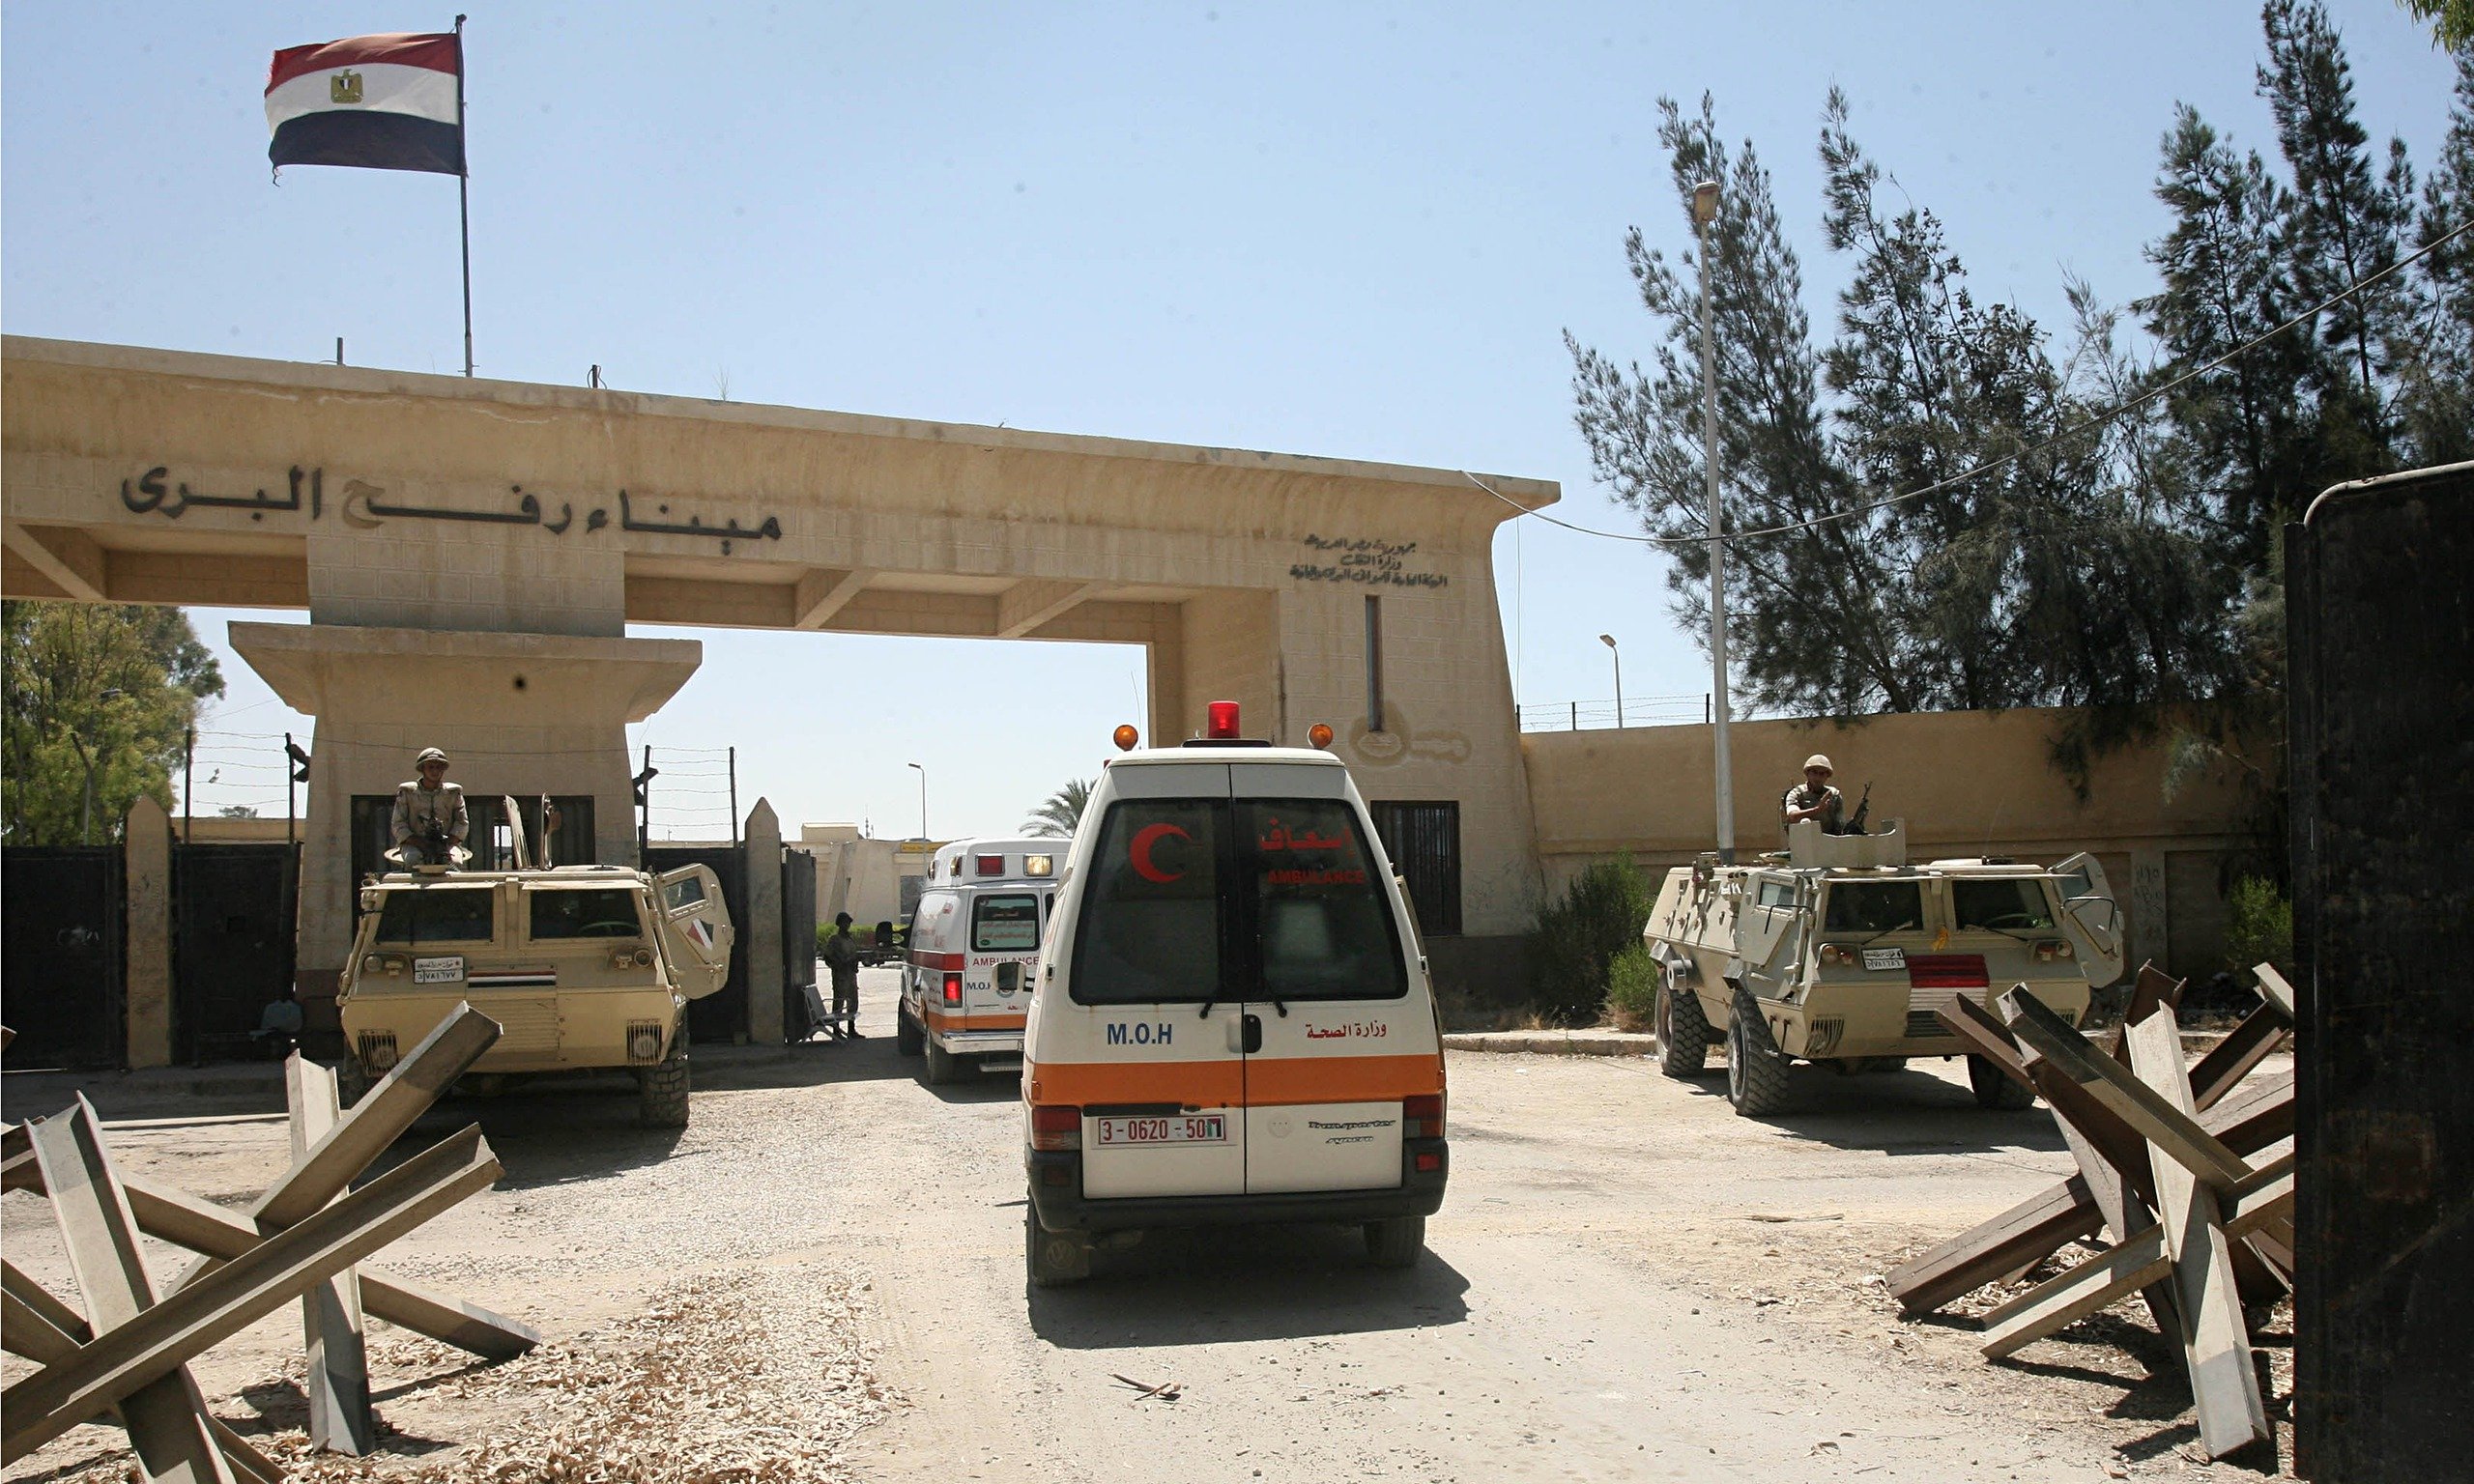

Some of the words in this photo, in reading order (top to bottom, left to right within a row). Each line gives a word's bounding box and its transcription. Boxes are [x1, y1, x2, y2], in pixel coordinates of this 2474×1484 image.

[586, 488, 783, 556] ميناء
[1258, 816, 1356, 860] إسعاف
[1267, 868, 1366, 886] AMBULANCE
[1107, 1023, 1172, 1045] M.O.H
[1305, 1023, 1352, 1039] الصحة
[1354, 1019, 1387, 1038] وزارة
